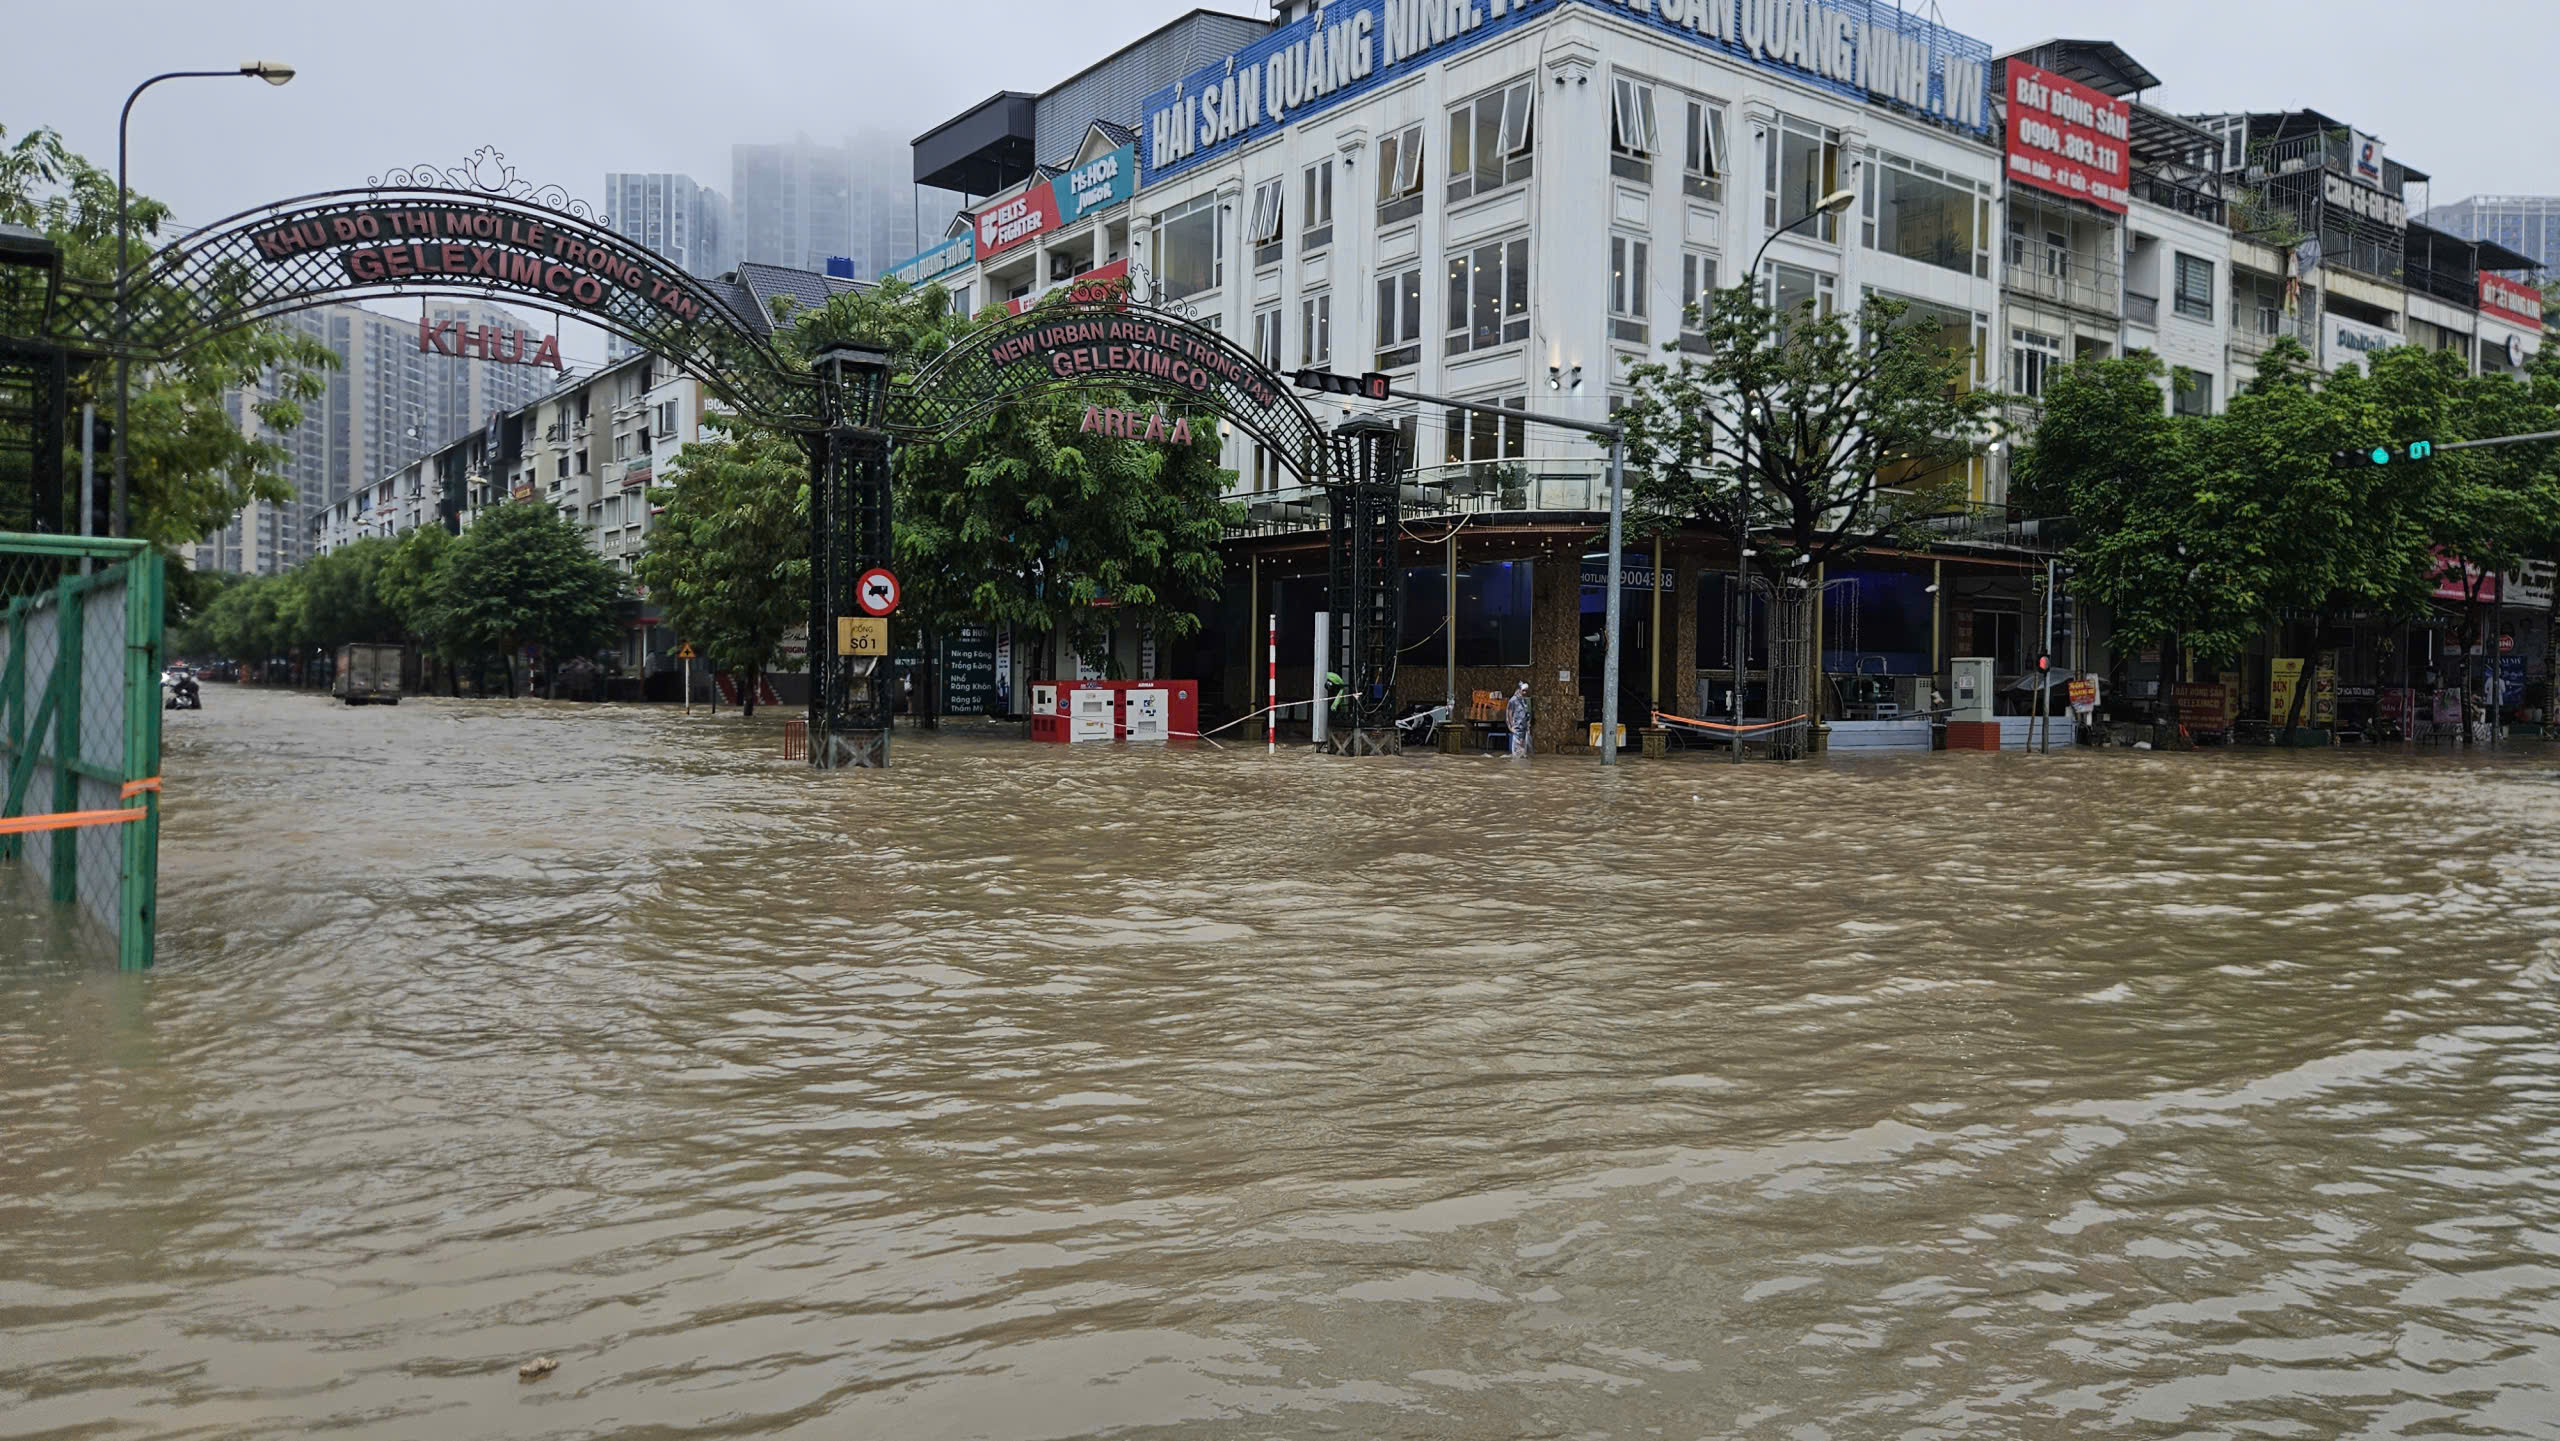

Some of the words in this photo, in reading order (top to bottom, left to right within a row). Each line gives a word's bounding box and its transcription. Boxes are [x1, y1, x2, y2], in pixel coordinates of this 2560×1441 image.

[1152, 82, 1196, 169] HẢI
[1201, 55, 1260, 146] SẢN
[1266, 9, 1374, 122] QUẢNG
[2016, 72, 2049, 111] BẤT
[2051, 88, 2094, 128] ĐỘNG
[2096, 102, 2127, 141] SẢN
[2019, 118, 2118, 174] 0904.803.111
[998, 198, 1027, 223] IELTS
[258, 221, 327, 257] KHU
[333, 211, 380, 241] ĐÔ
[385, 211, 438, 237] THỊ
[446, 209, 500, 239] MỚI
[512, 223, 544, 249] LÊ
[552, 233, 645, 289] TRỌNG
[351, 244, 601, 304] GELEXIMCO
[420, 317, 523, 364] KHU
[532, 334, 563, 371] A
[991, 334, 1035, 366] NEW
[1039, 322, 1105, 348] URBAN
[1109, 321, 1157, 345] AREA
[1161, 331, 1182, 349] LE
[1185, 337, 1241, 382] TRONG
[1243, 374, 1277, 408] TAN
[1053, 347, 1208, 391] GELEXIMCO
[1080, 405, 1166, 443] AREA
[1170, 417, 1192, 447] A
[850, 634, 868, 649] SỐ
[870, 638, 876, 649] 1
